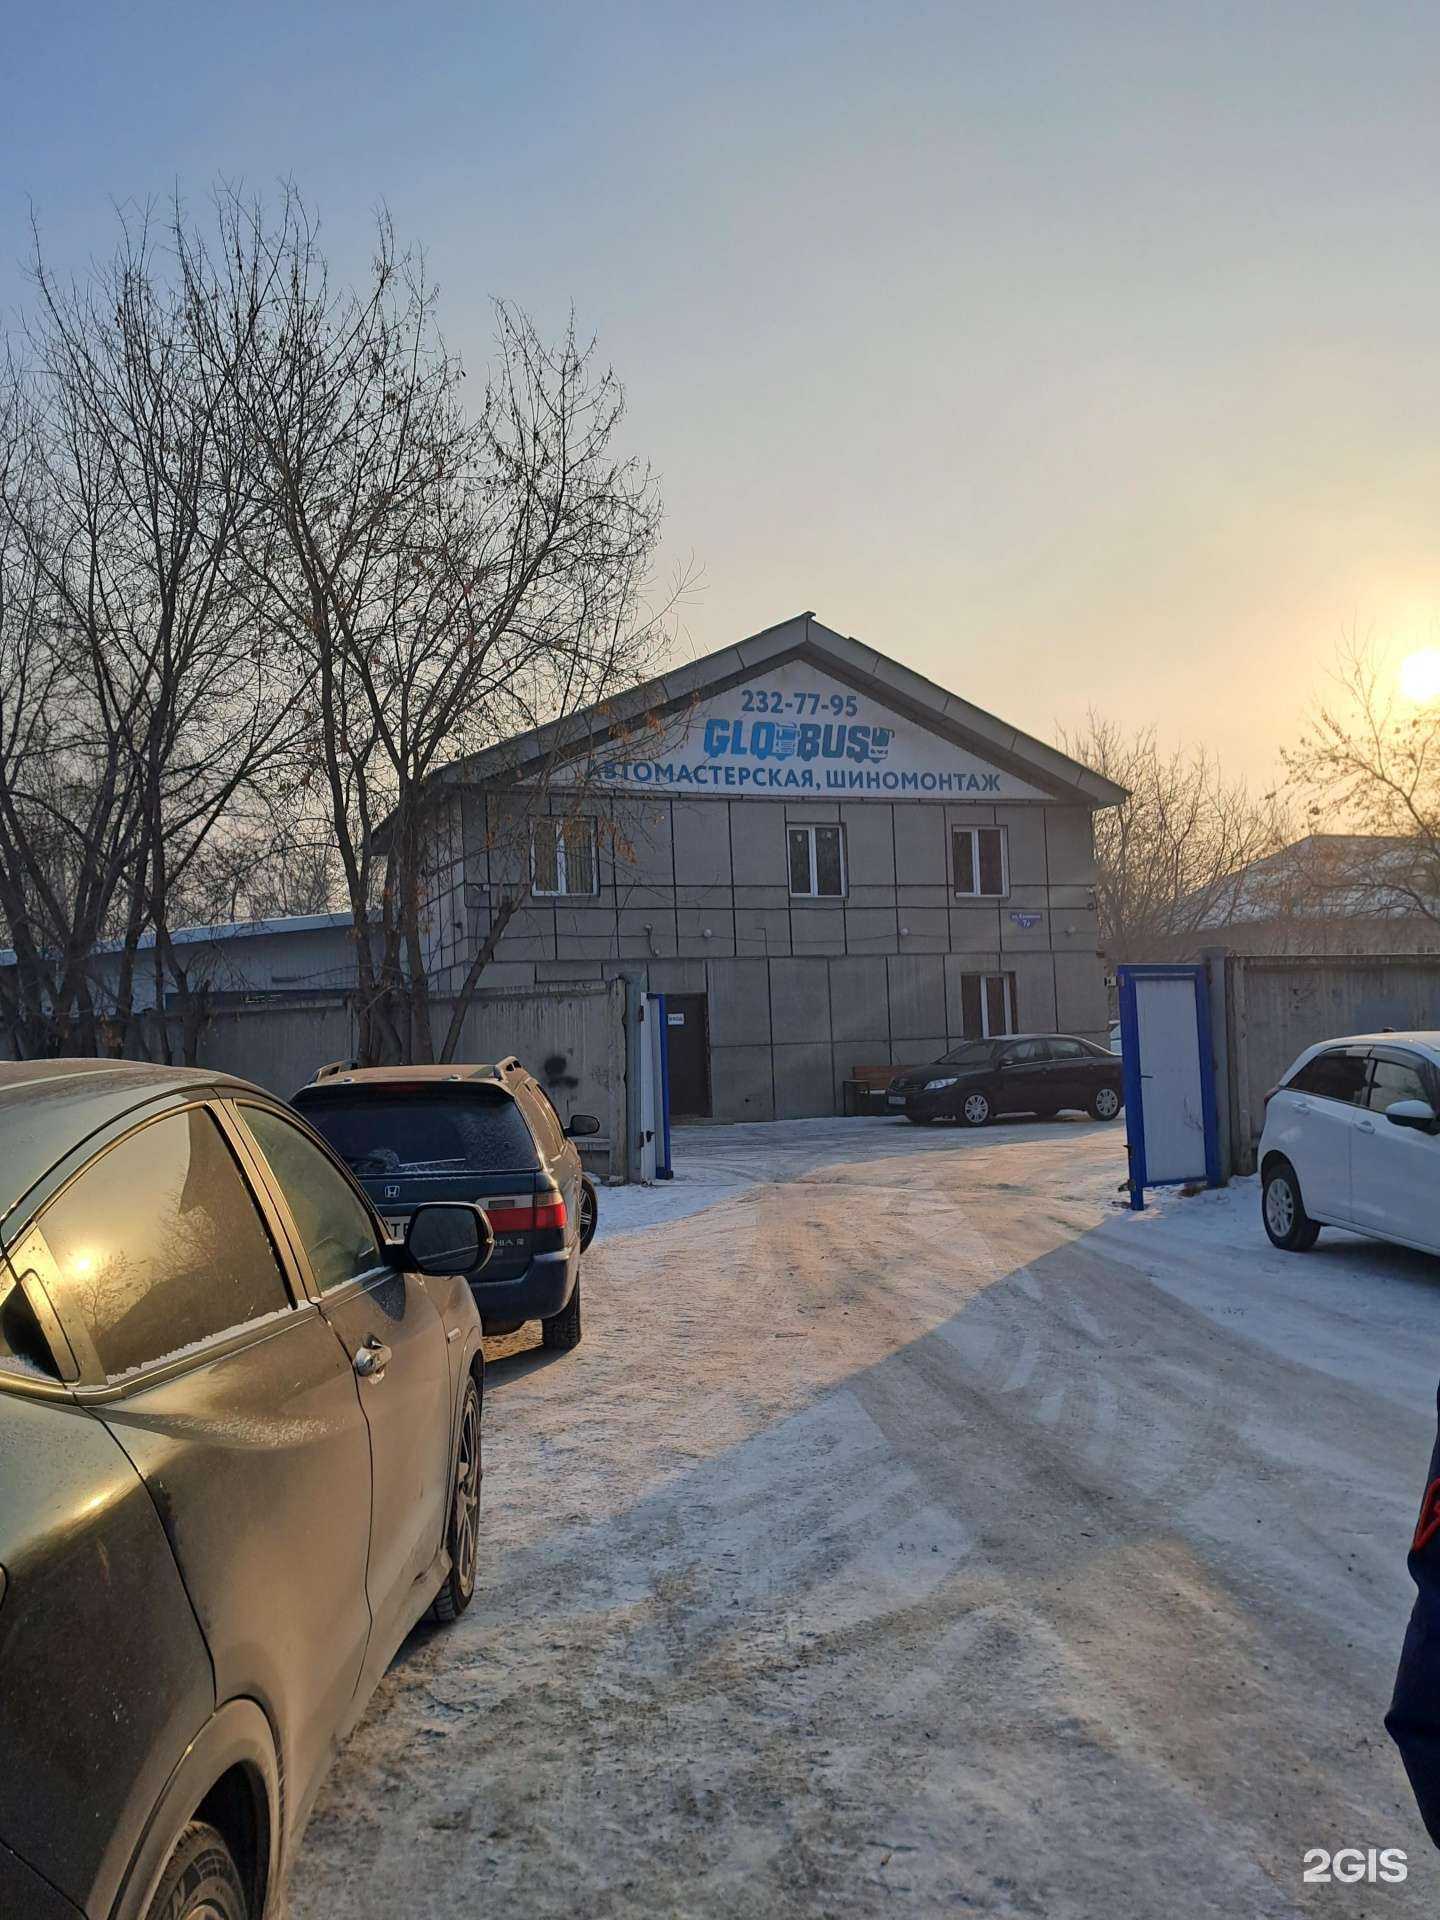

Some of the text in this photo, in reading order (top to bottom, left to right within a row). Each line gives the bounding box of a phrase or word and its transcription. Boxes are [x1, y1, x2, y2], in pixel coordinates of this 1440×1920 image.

[741, 689, 858, 717] 232-77-95
[703, 718, 871, 763] GLOBUS
[826, 769, 1000, 792] ШИНОМОНТАЖ
